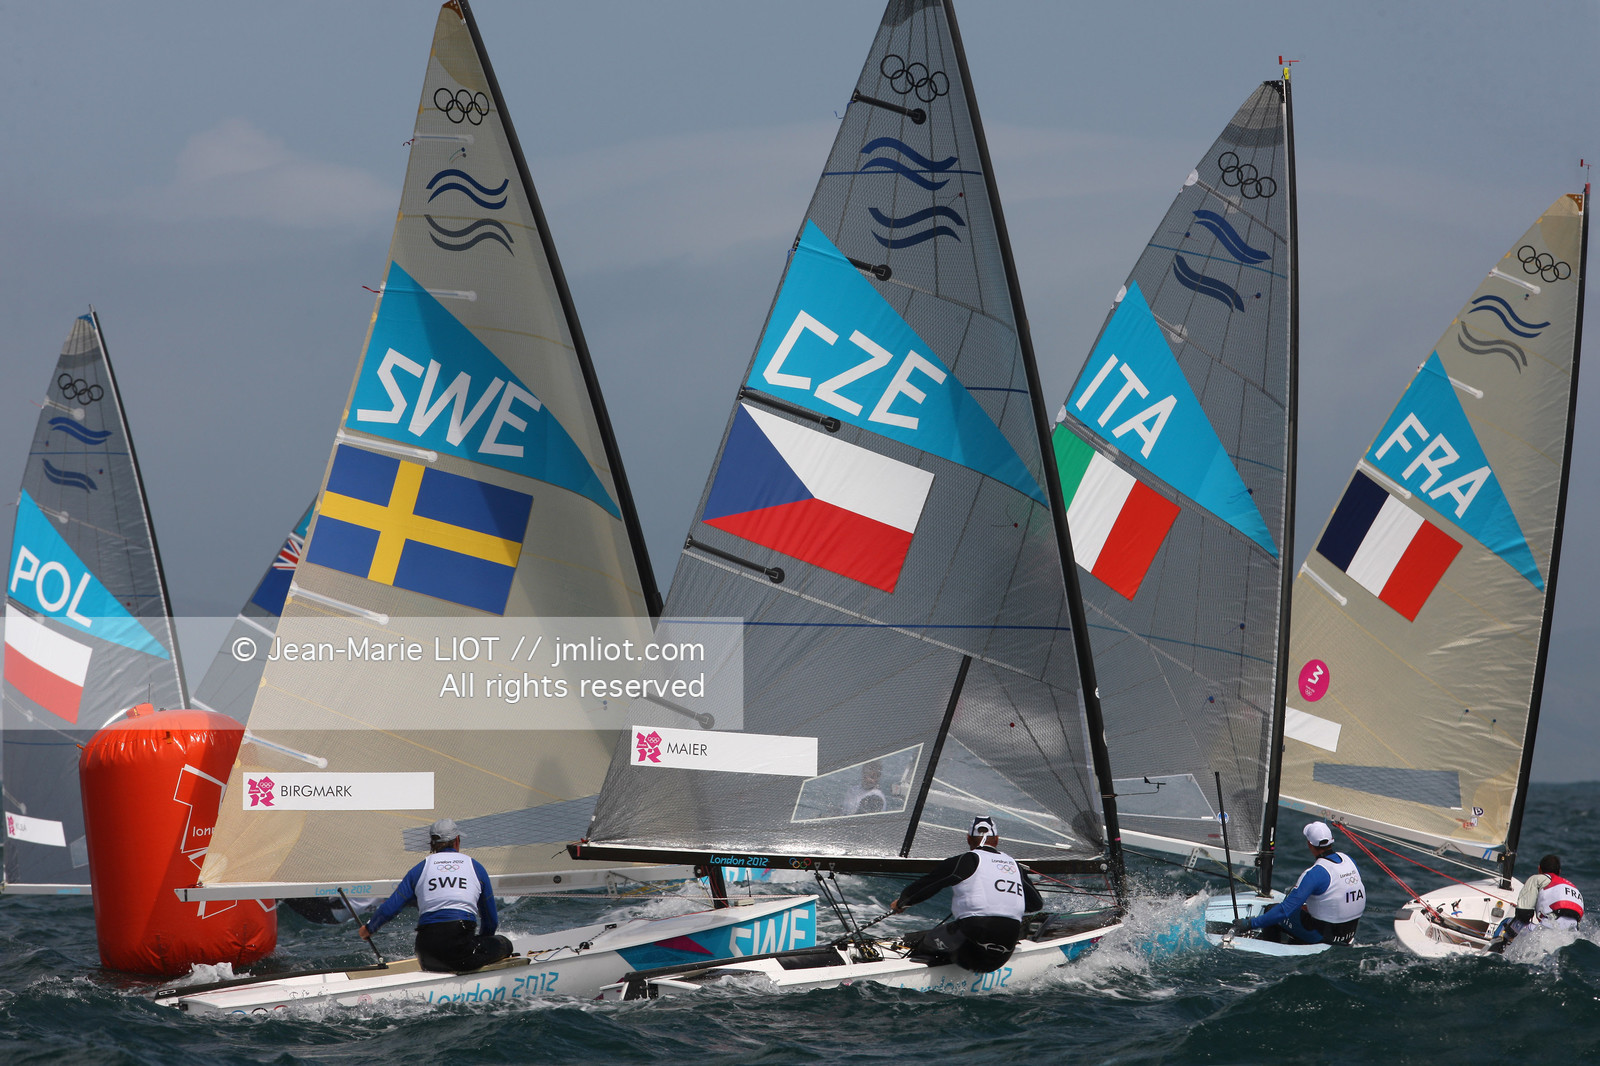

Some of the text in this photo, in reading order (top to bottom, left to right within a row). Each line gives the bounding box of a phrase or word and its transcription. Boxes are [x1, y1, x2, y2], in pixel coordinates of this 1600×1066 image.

[763, 310, 947, 430] CZE
[357, 348, 542, 458] SWE
[1075, 354, 1178, 460] ITA
[1375, 412, 1492, 519] FRA
[10, 545, 92, 628] POL
[667, 742, 708, 756] MAIER
[280, 785, 352, 797] BIRGMARK
[710, 854, 768, 866] London 2012
[428, 876, 467, 891] SWE
[994, 879, 1023, 897] CZE
[1345, 889, 1364, 903] ITA
[512, 971, 560, 998] 2012
